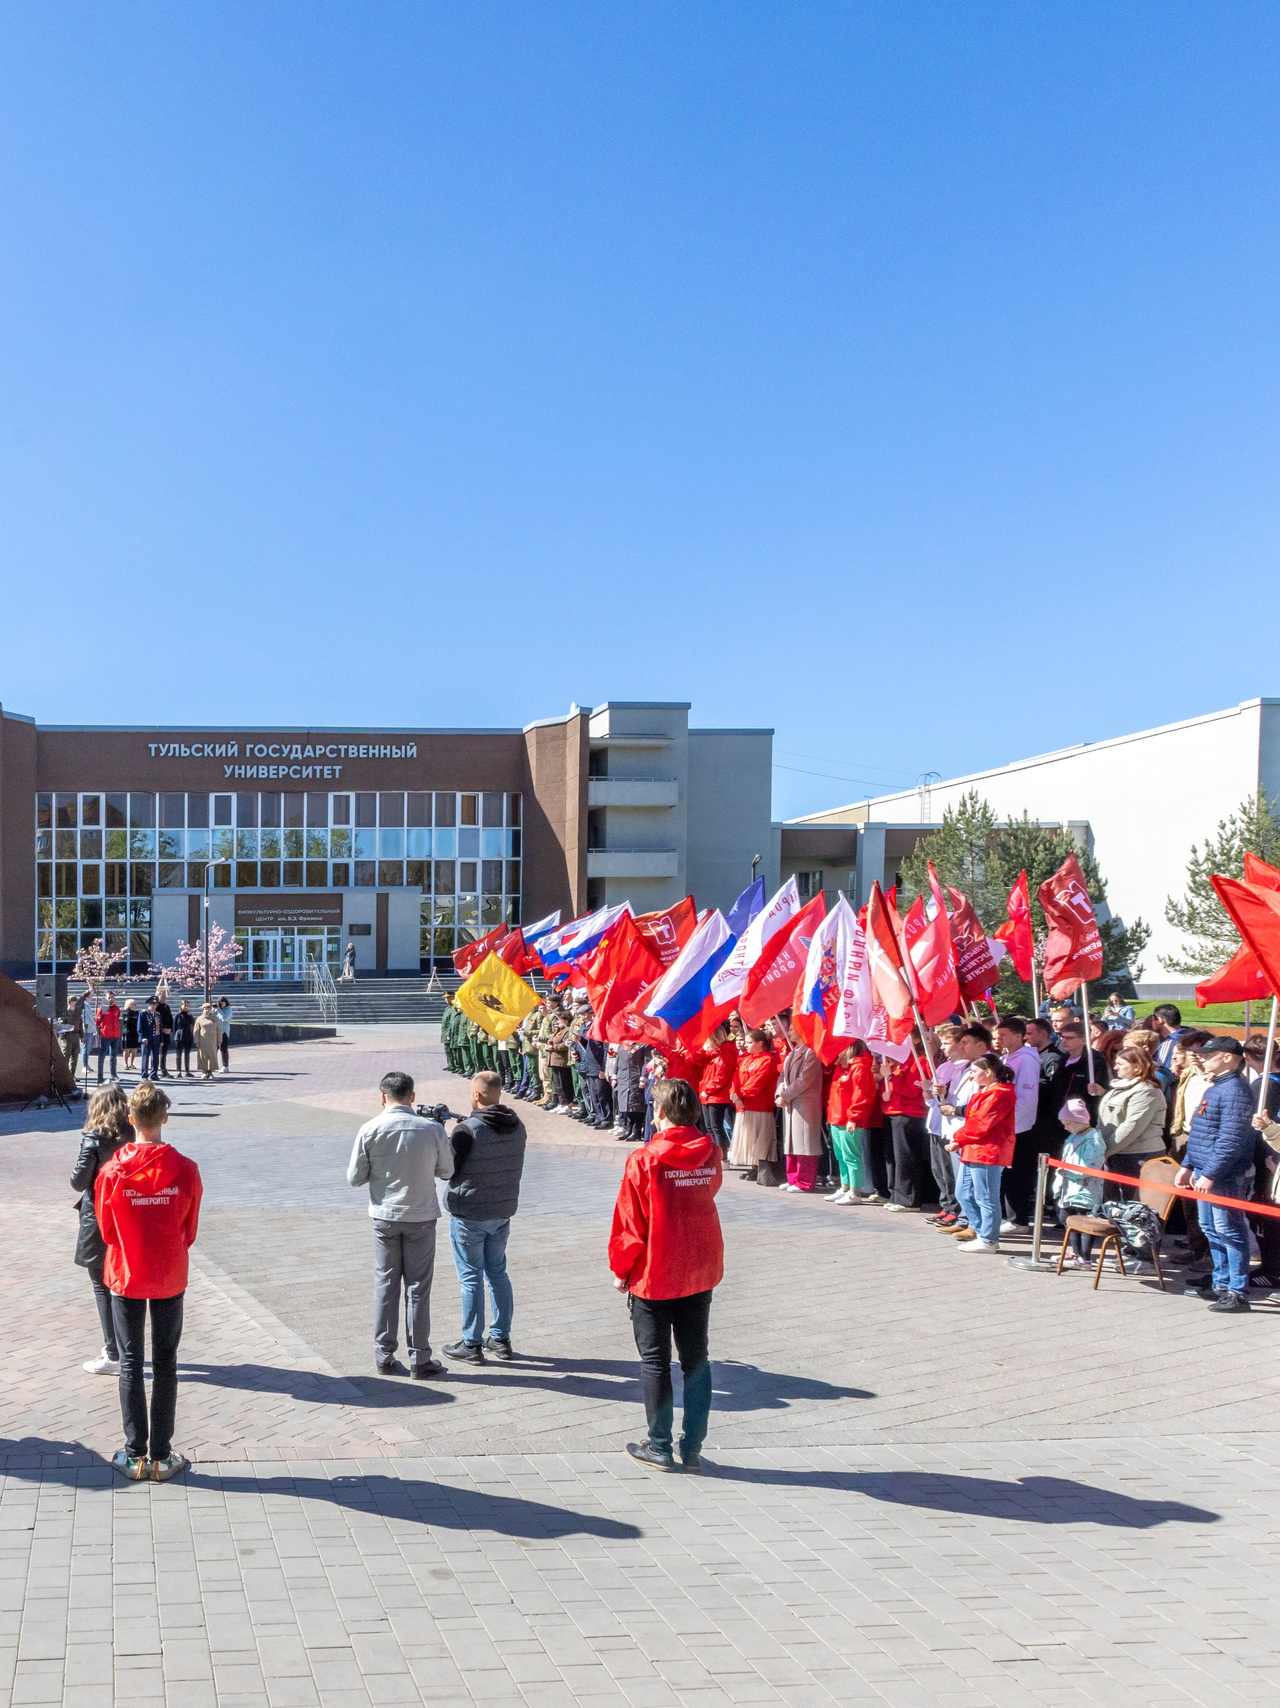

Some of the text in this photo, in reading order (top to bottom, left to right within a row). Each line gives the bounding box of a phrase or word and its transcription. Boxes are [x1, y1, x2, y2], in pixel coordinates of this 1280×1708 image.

[148, 741, 417, 760] ТУЛЬСКИЙ ГОСУДАРСТВЕННЫЙ
[224, 765, 342, 779] УНИВЕРСИТЕТ
[131, 1197, 170, 1206] УНИВЕРСИТЕТ
